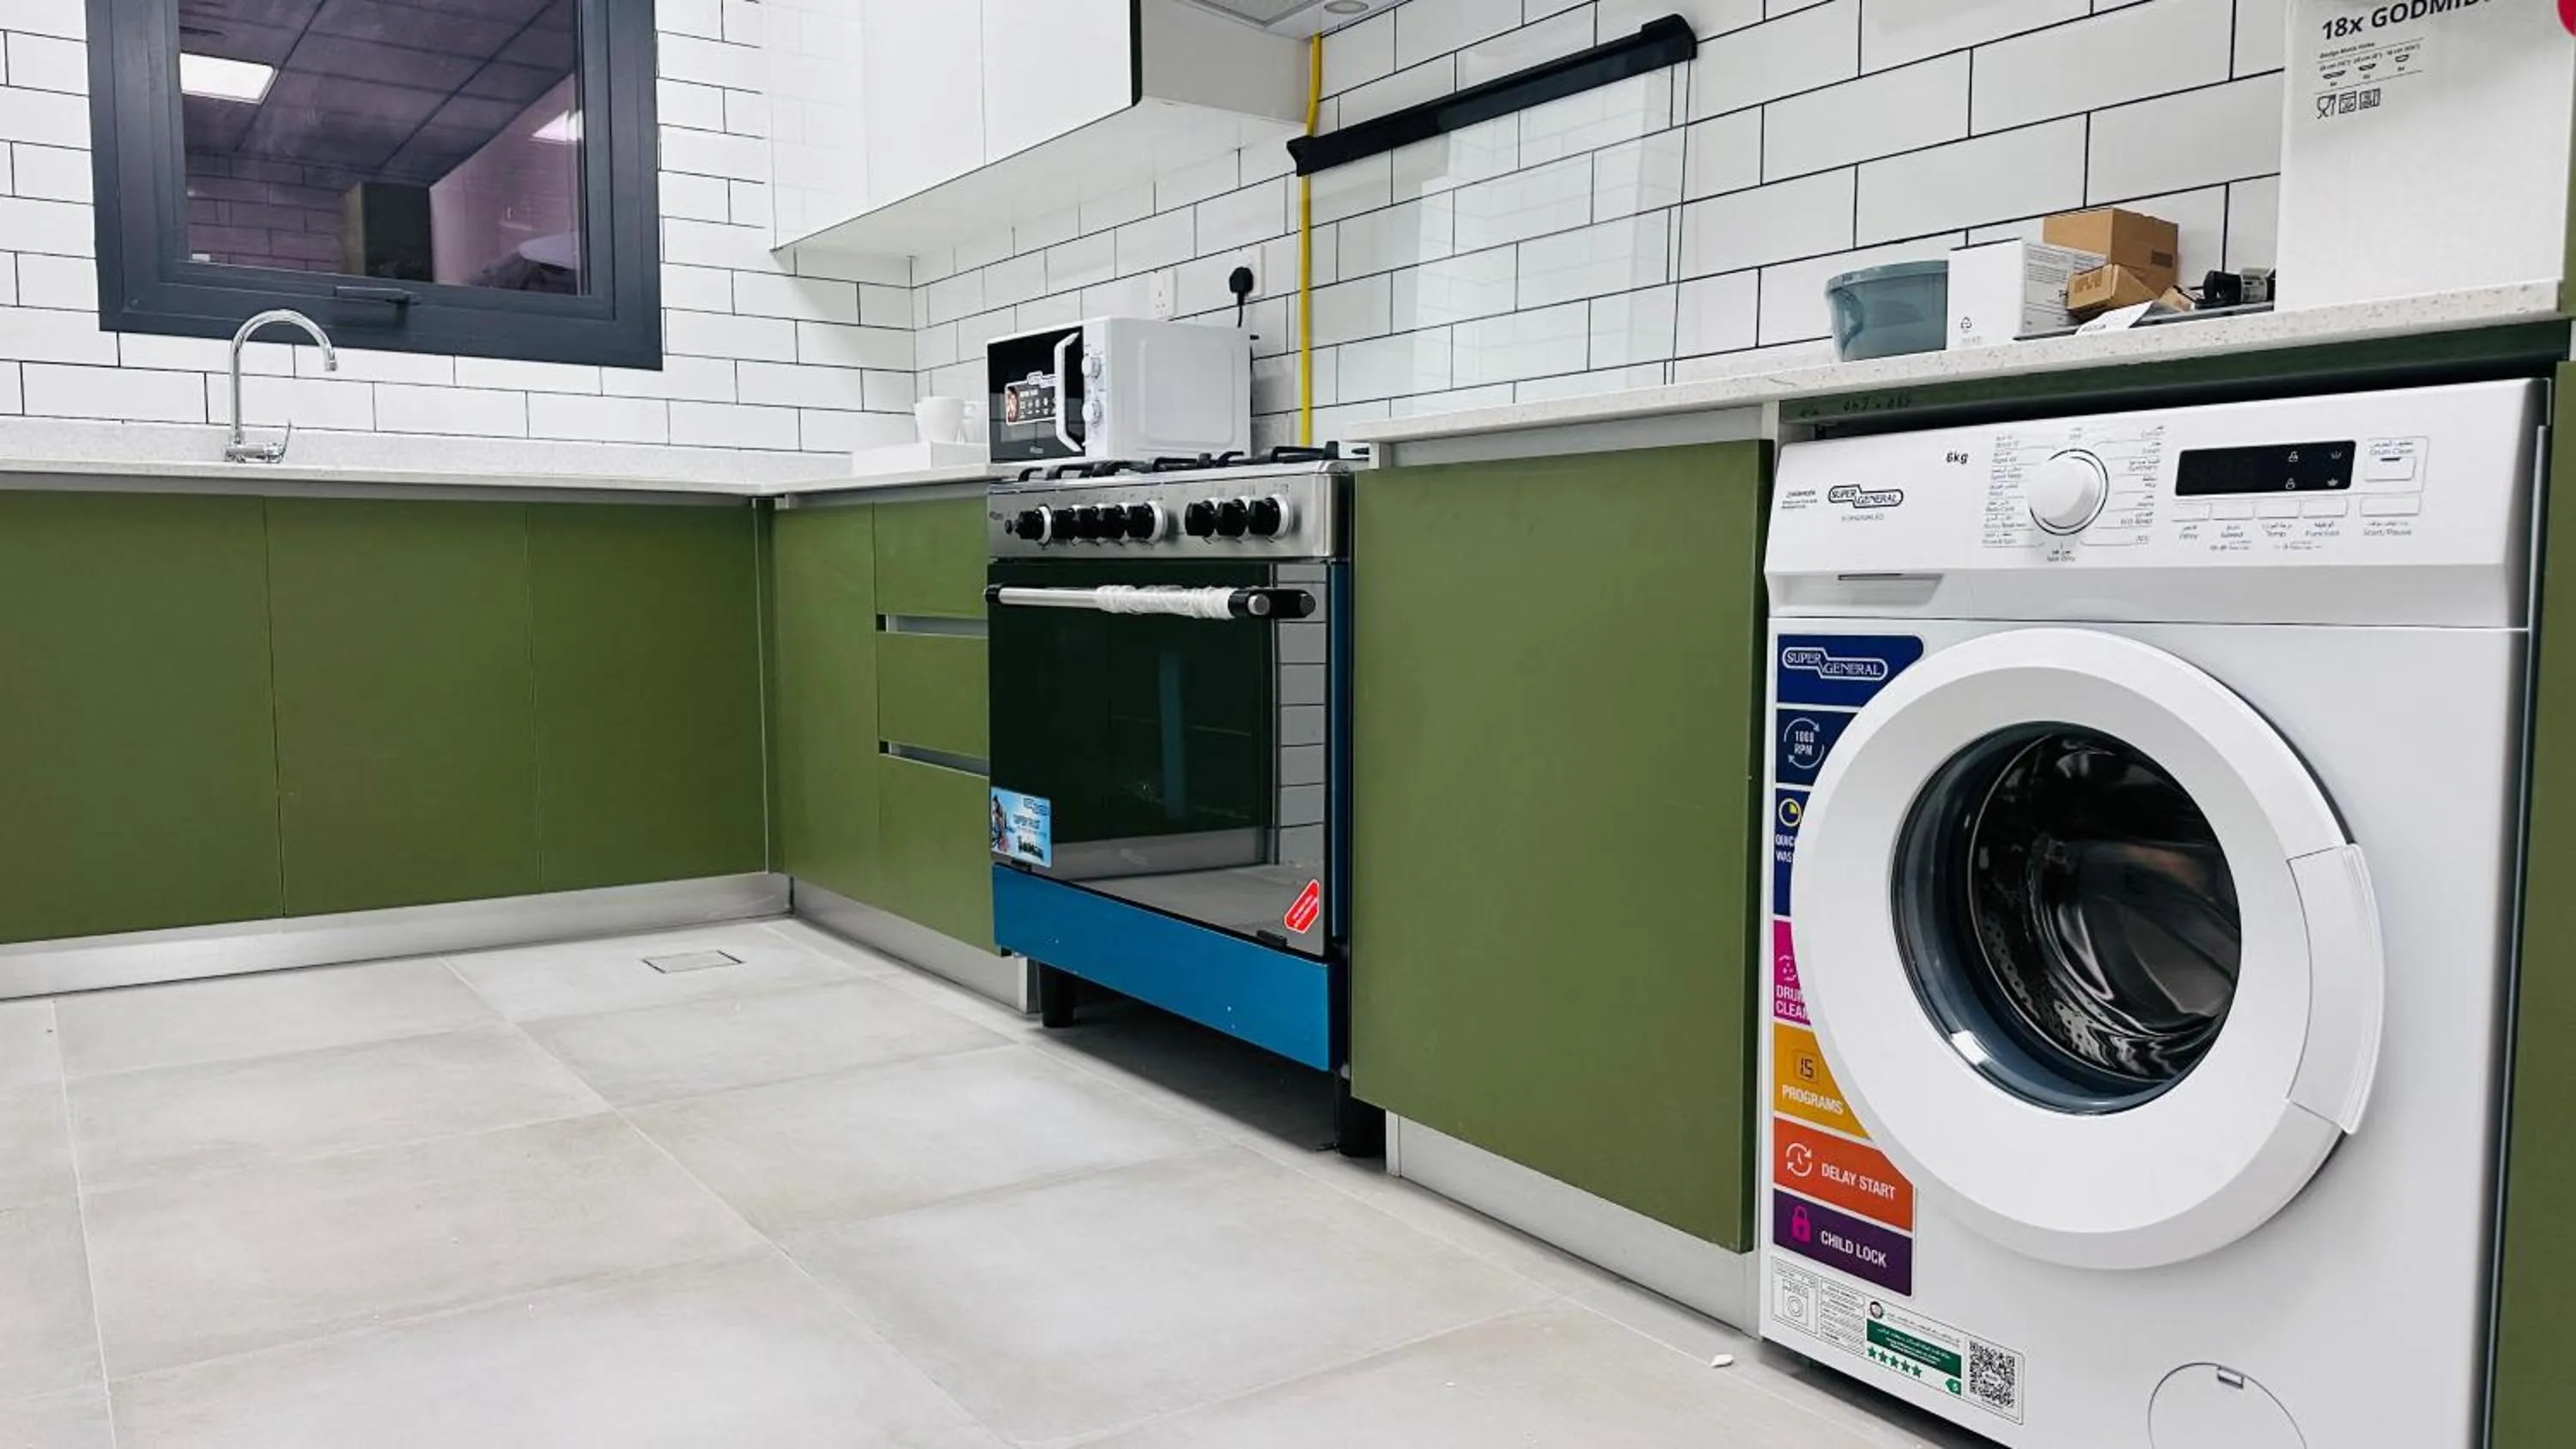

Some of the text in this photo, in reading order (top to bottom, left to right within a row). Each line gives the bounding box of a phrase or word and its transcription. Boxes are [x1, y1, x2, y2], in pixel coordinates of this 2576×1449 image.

[2322, 0, 2490, 39] 18x GODM
[1946, 452, 1969, 464] 6kg
[1832, 488, 1857, 499] SUPER
[1856, 494, 1897, 505] GENERAL
[1787, 652, 1821, 664] SUPER
[1822, 662, 1882, 676] GENERAL
[1795, 731, 1814, 743] 1000
[1794, 743, 1813, 755] RPM
[1775, 834, 1795, 847] QUIC
[1776, 850, 1792, 863] WAS
[1782, 1084, 1844, 1115] PROGRAMS
[1821, 1162, 1896, 1201] DELAY START
[1820, 1230, 1887, 1268] CHILD LOCK
